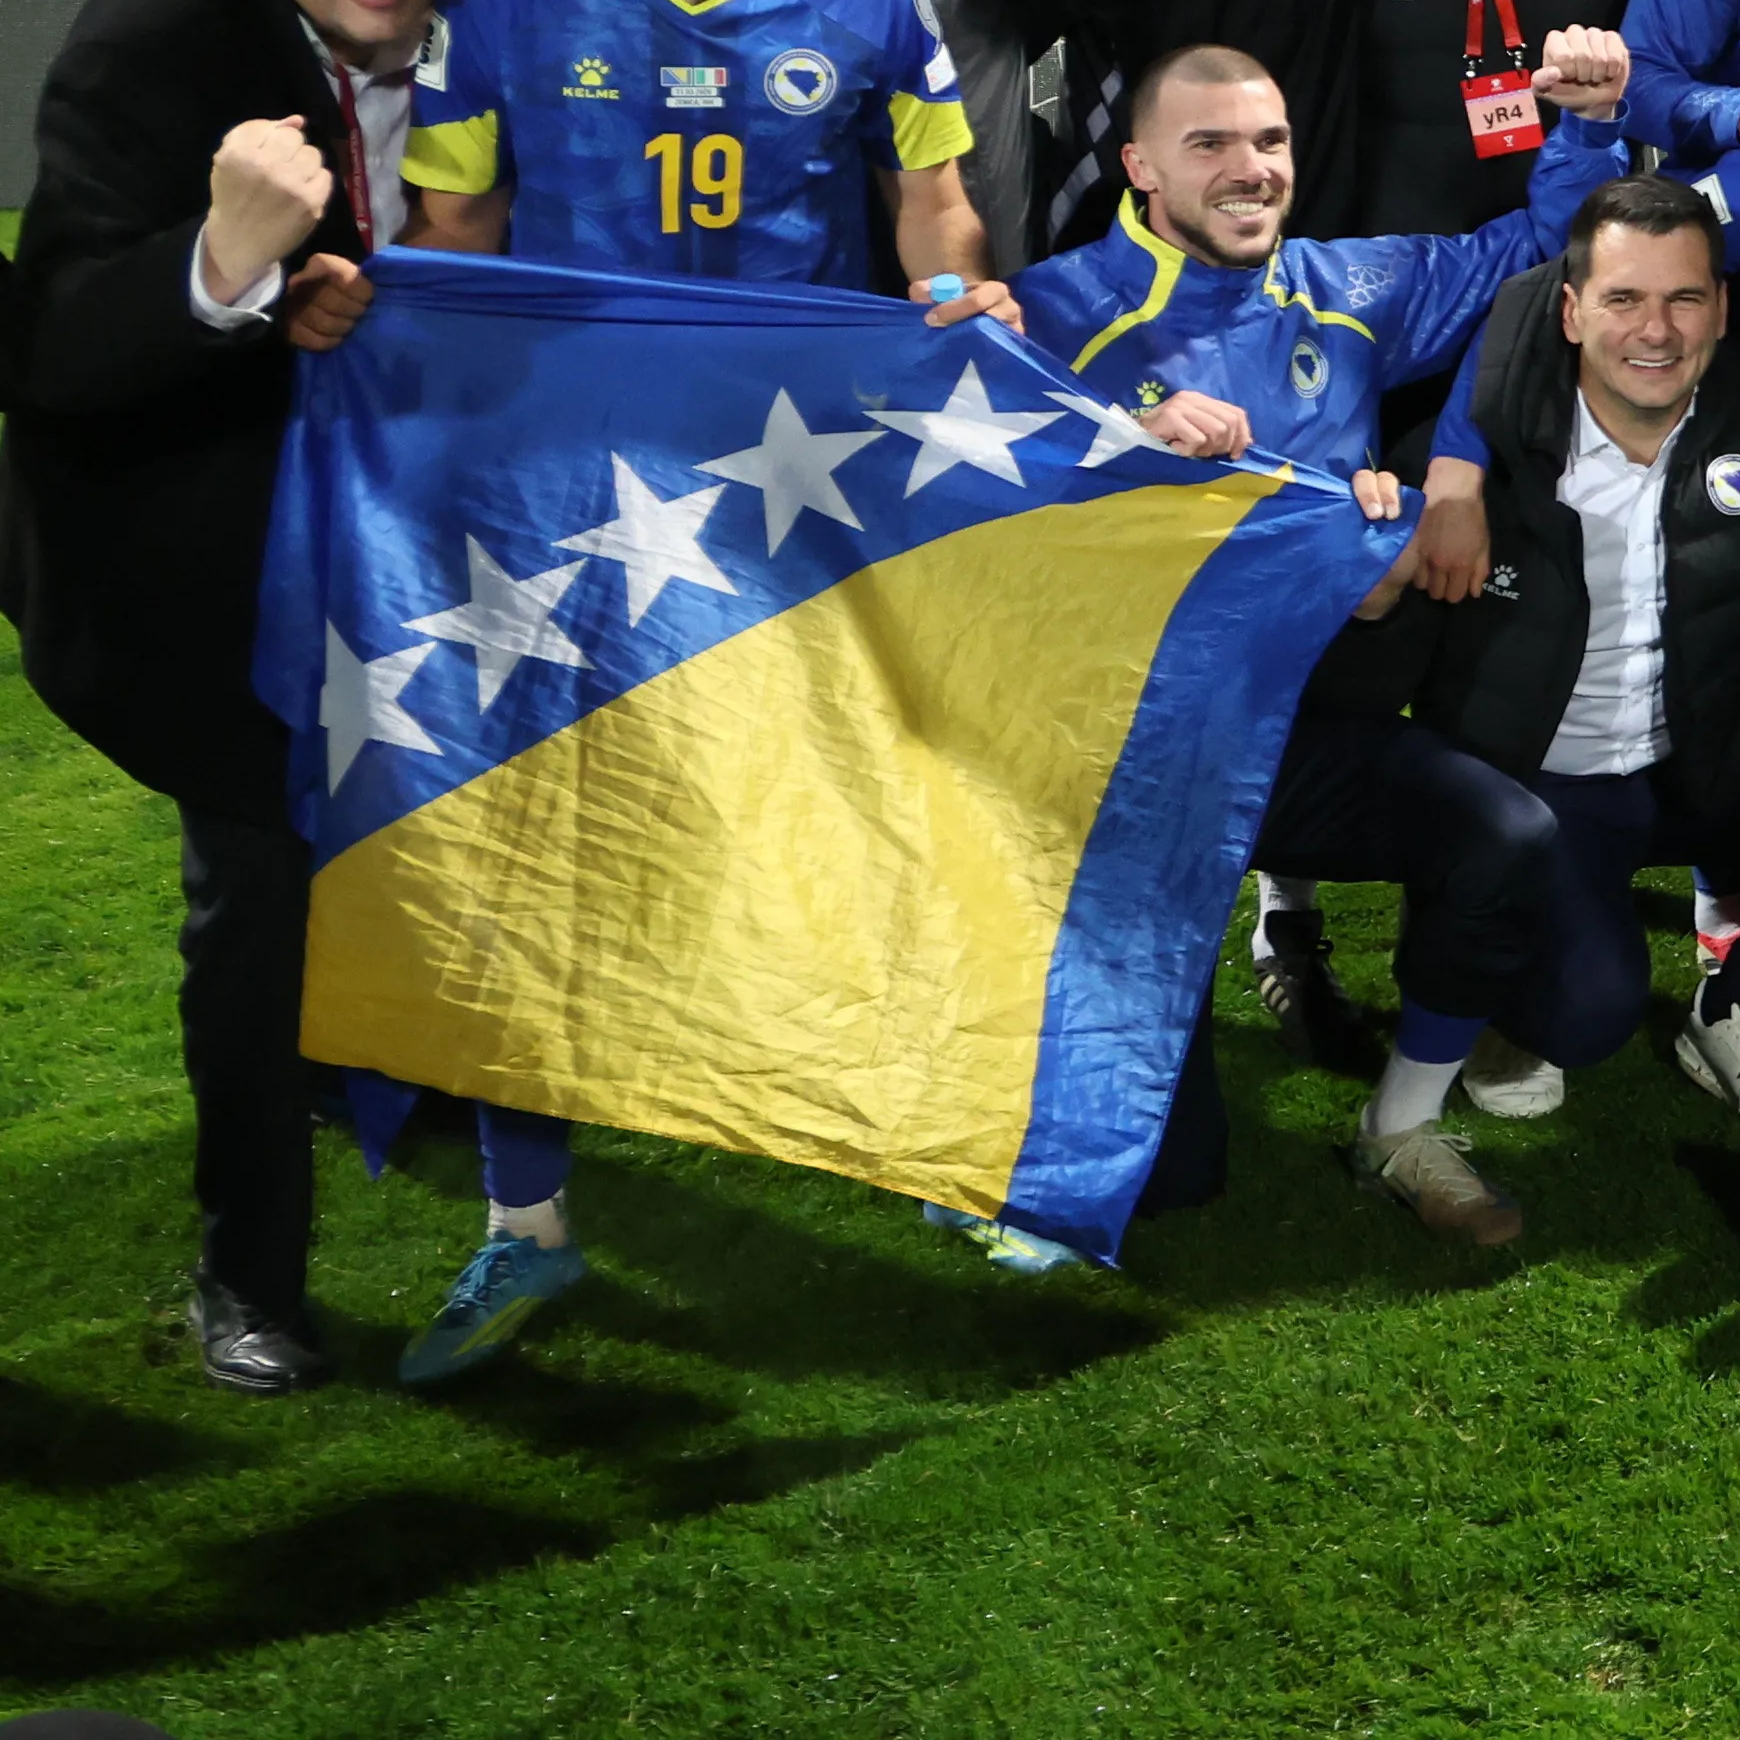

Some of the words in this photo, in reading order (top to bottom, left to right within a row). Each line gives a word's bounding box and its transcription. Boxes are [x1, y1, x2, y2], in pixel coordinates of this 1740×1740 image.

[562, 87, 620, 100] KELME
[1483, 104, 1524, 129] yR4
[645, 133, 744, 234] 19
